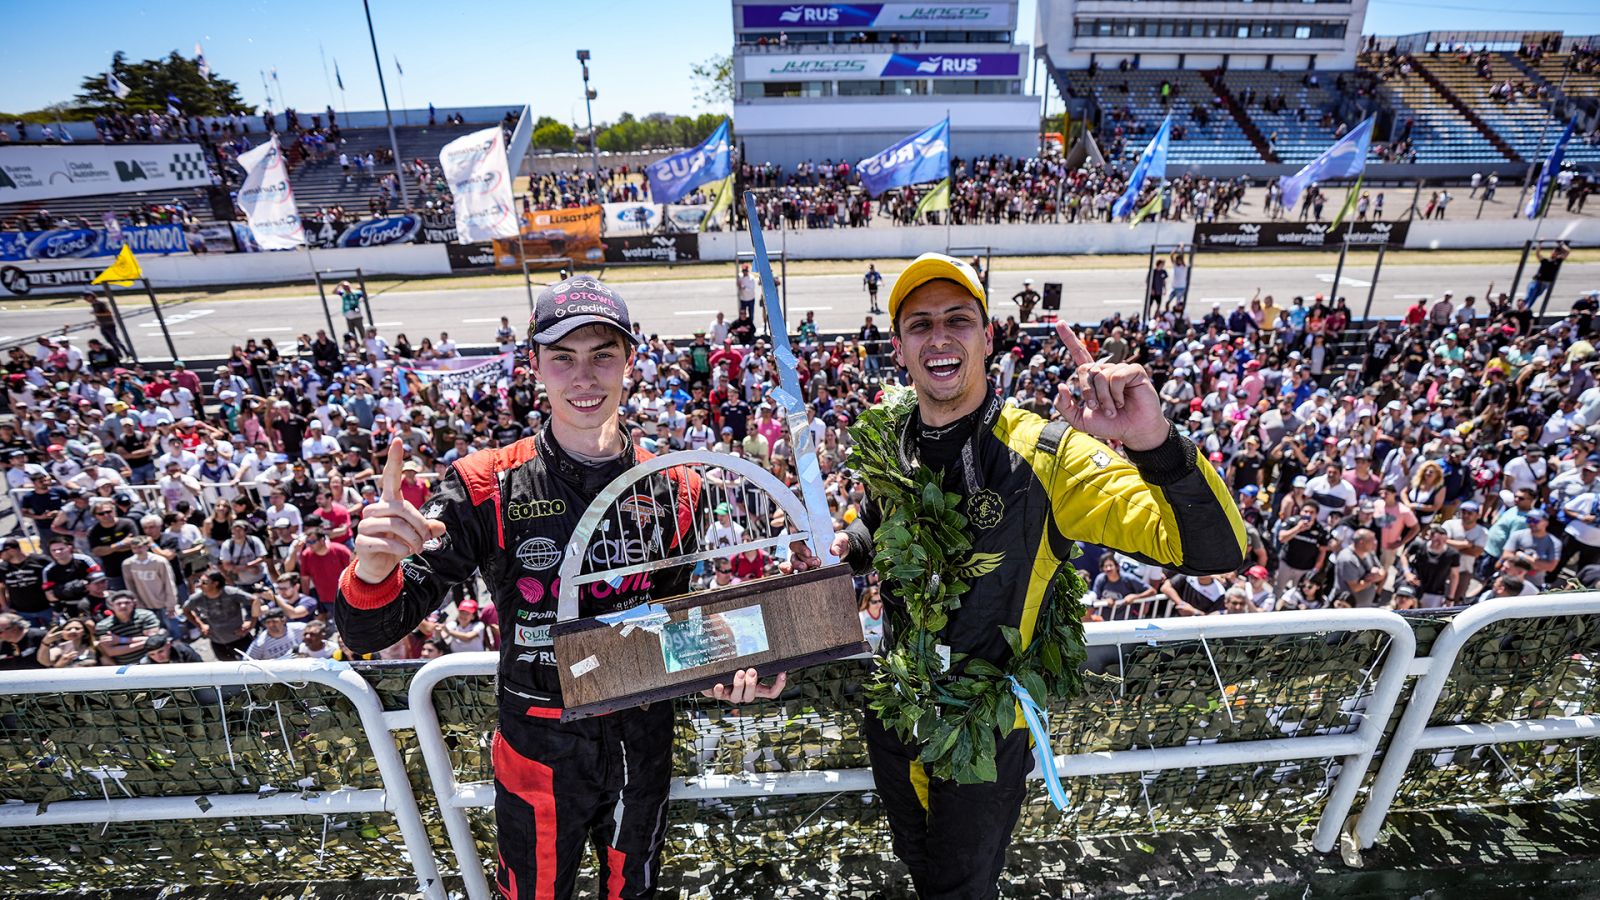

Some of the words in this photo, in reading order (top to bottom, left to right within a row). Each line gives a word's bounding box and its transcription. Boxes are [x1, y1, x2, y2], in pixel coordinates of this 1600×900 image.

[804, 8, 839, 21] RUS
[942, 58, 978, 72] RUS
[359, 219, 404, 247] Ford
[46, 233, 87, 258] Ford
[570, 292, 619, 310] OTOWIL
[508, 499, 567, 521] COIRO
[550, 572, 652, 600] OOWIL
